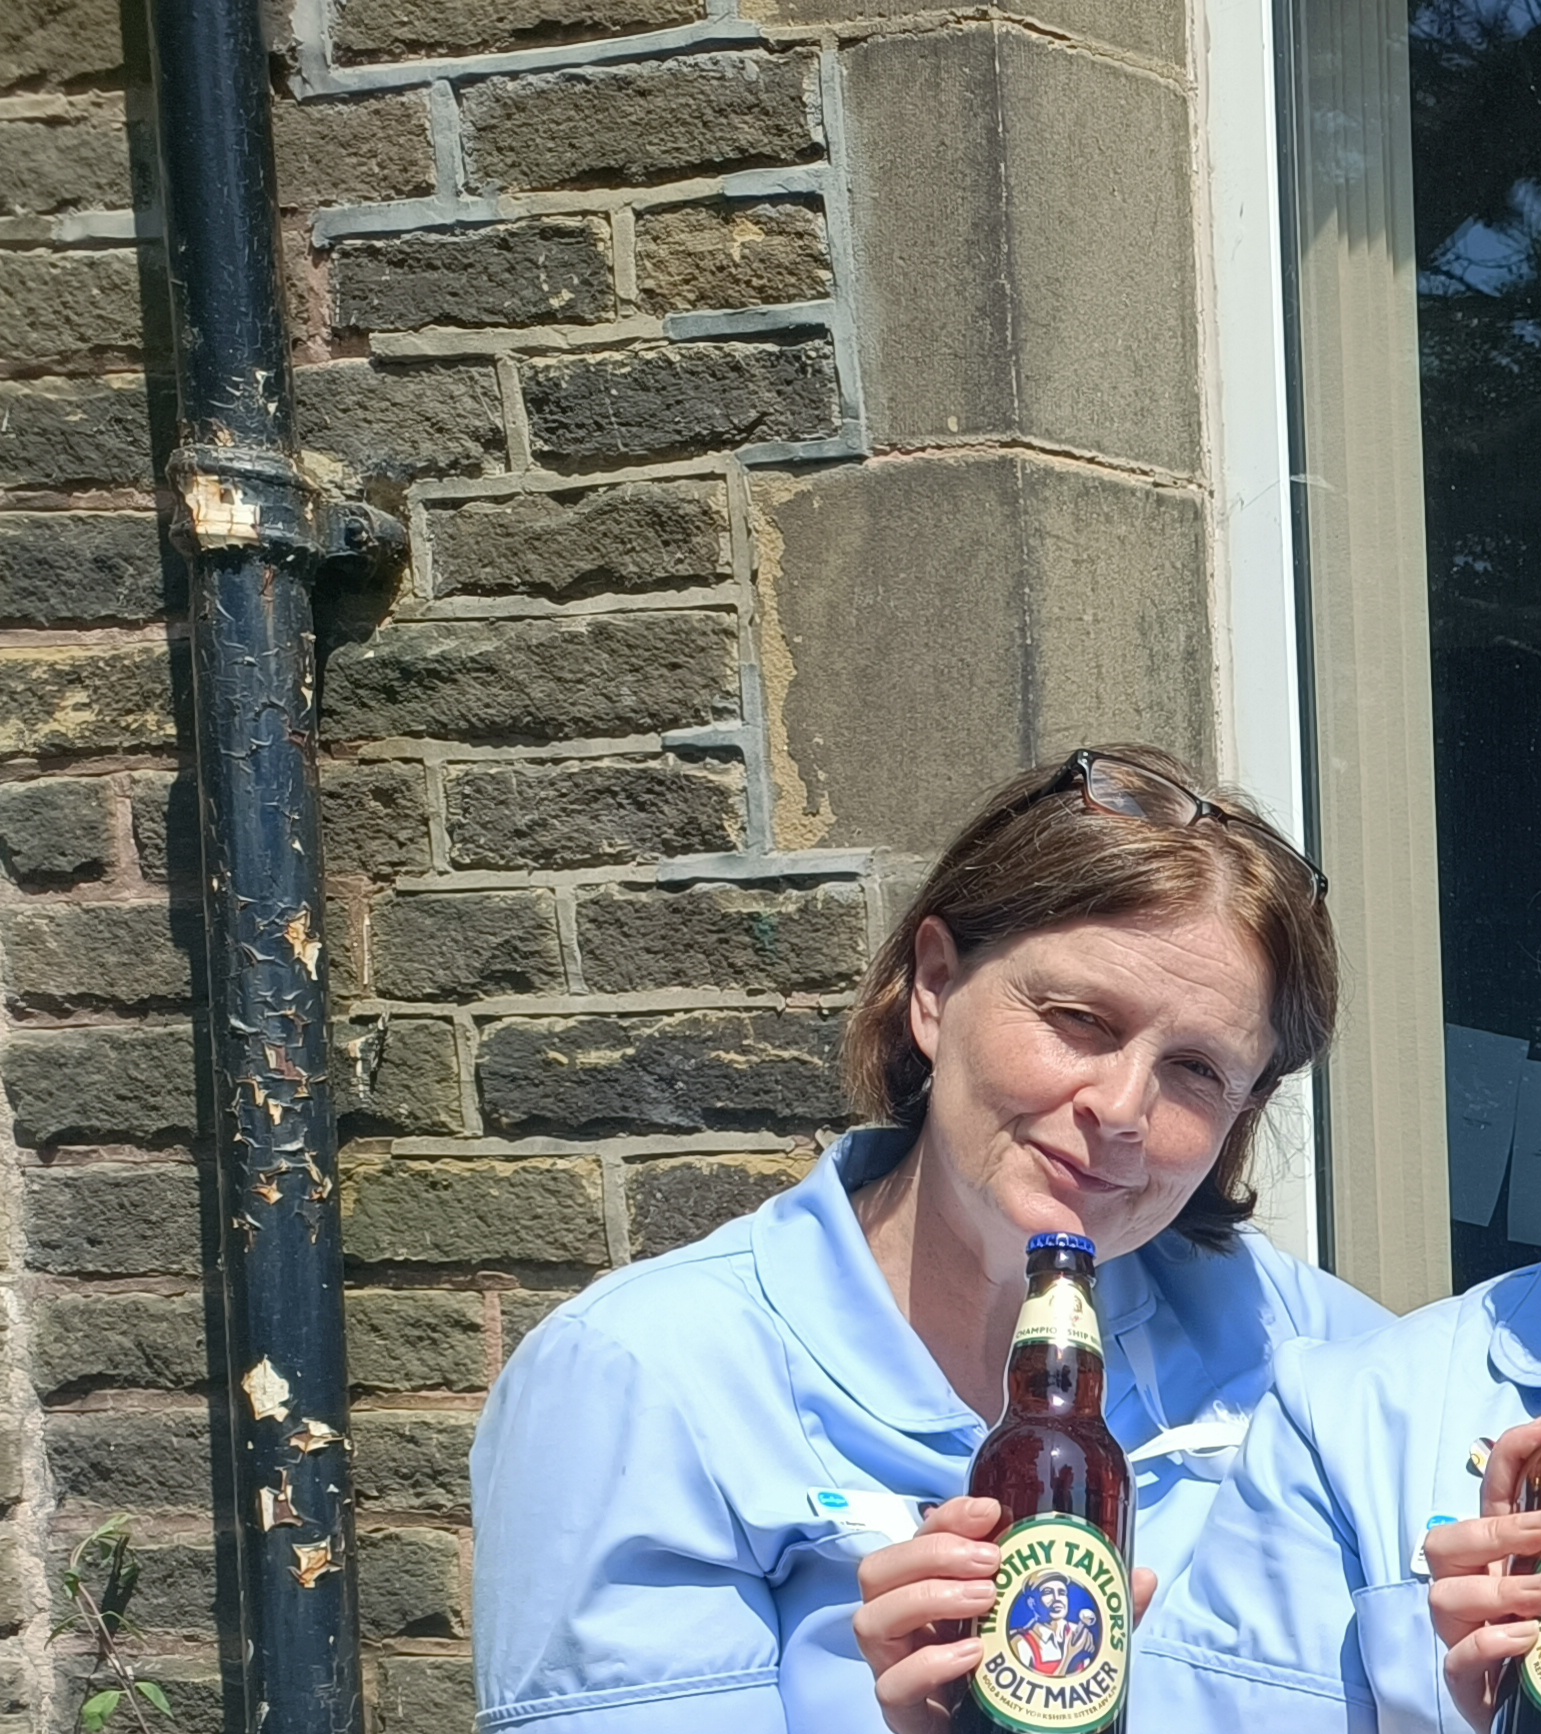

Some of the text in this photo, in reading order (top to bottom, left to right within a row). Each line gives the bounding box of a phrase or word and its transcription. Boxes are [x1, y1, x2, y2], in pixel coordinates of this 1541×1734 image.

[1016, 1326, 1089, 1340] CHAMPIOSHIP
[1064, 1541, 1126, 1653] TAYLOR'S
[984, 1650, 1119, 1710] BOLTMAKER
